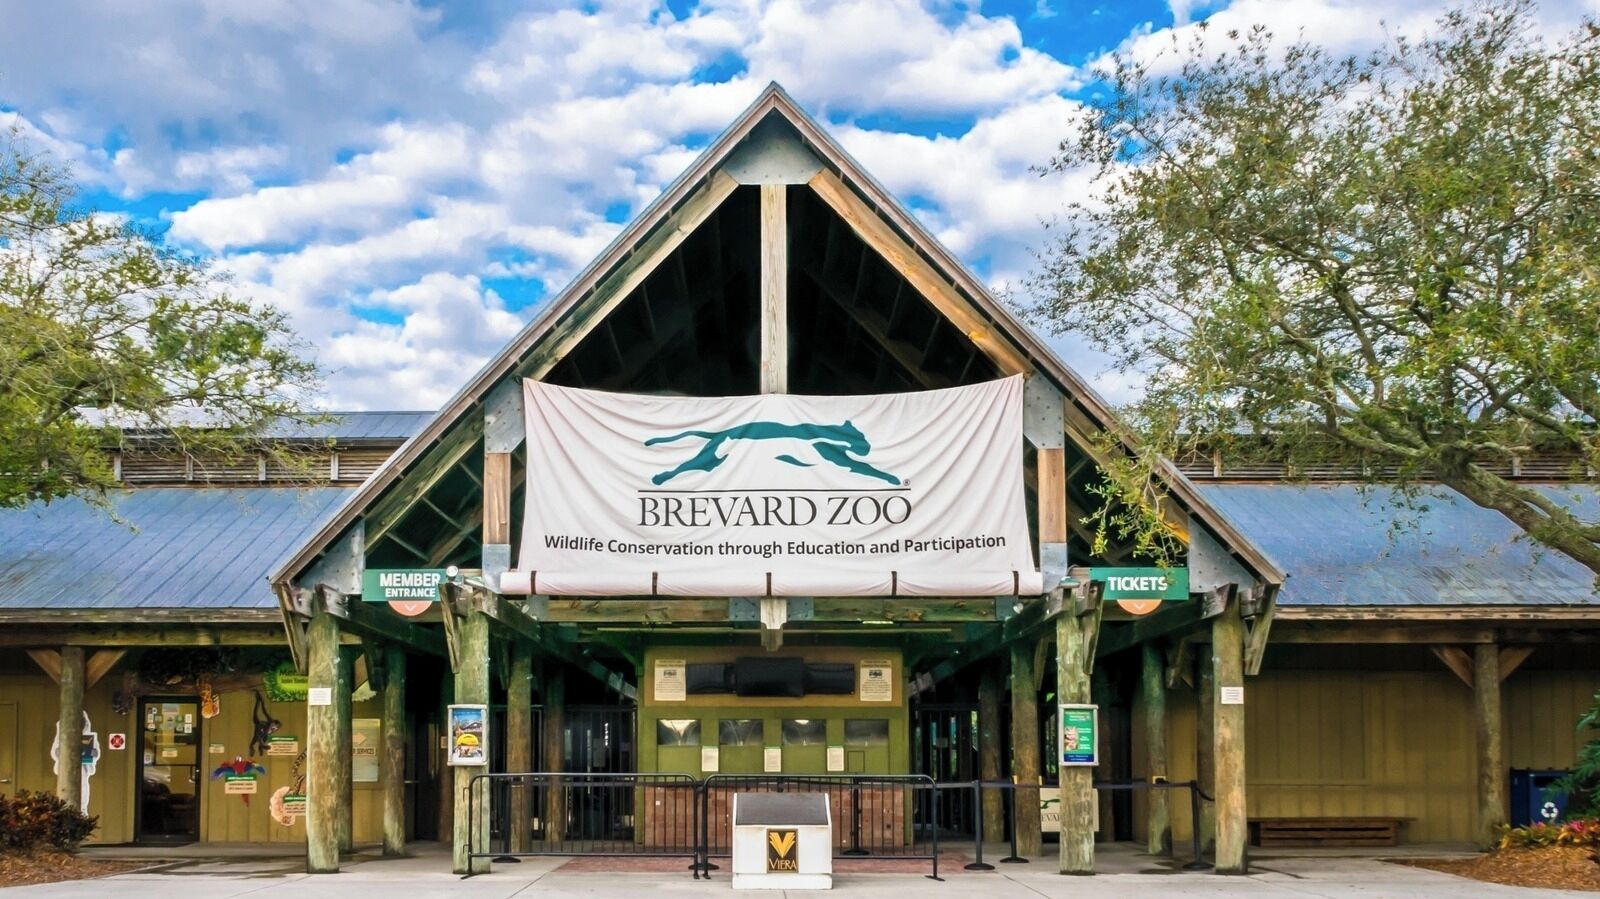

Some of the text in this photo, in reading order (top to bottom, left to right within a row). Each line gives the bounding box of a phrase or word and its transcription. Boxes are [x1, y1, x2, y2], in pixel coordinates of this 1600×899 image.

[637, 495, 912, 528] BREVARD ZOO
[544, 534, 1006, 559] Wildlife Conservation through Education and Participation
[380, 572, 440, 587] MEMBER
[1107, 576, 1168, 591] TICKETS
[385, 587, 436, 597] ENTRANCE
[769, 857, 797, 870] VIERA
